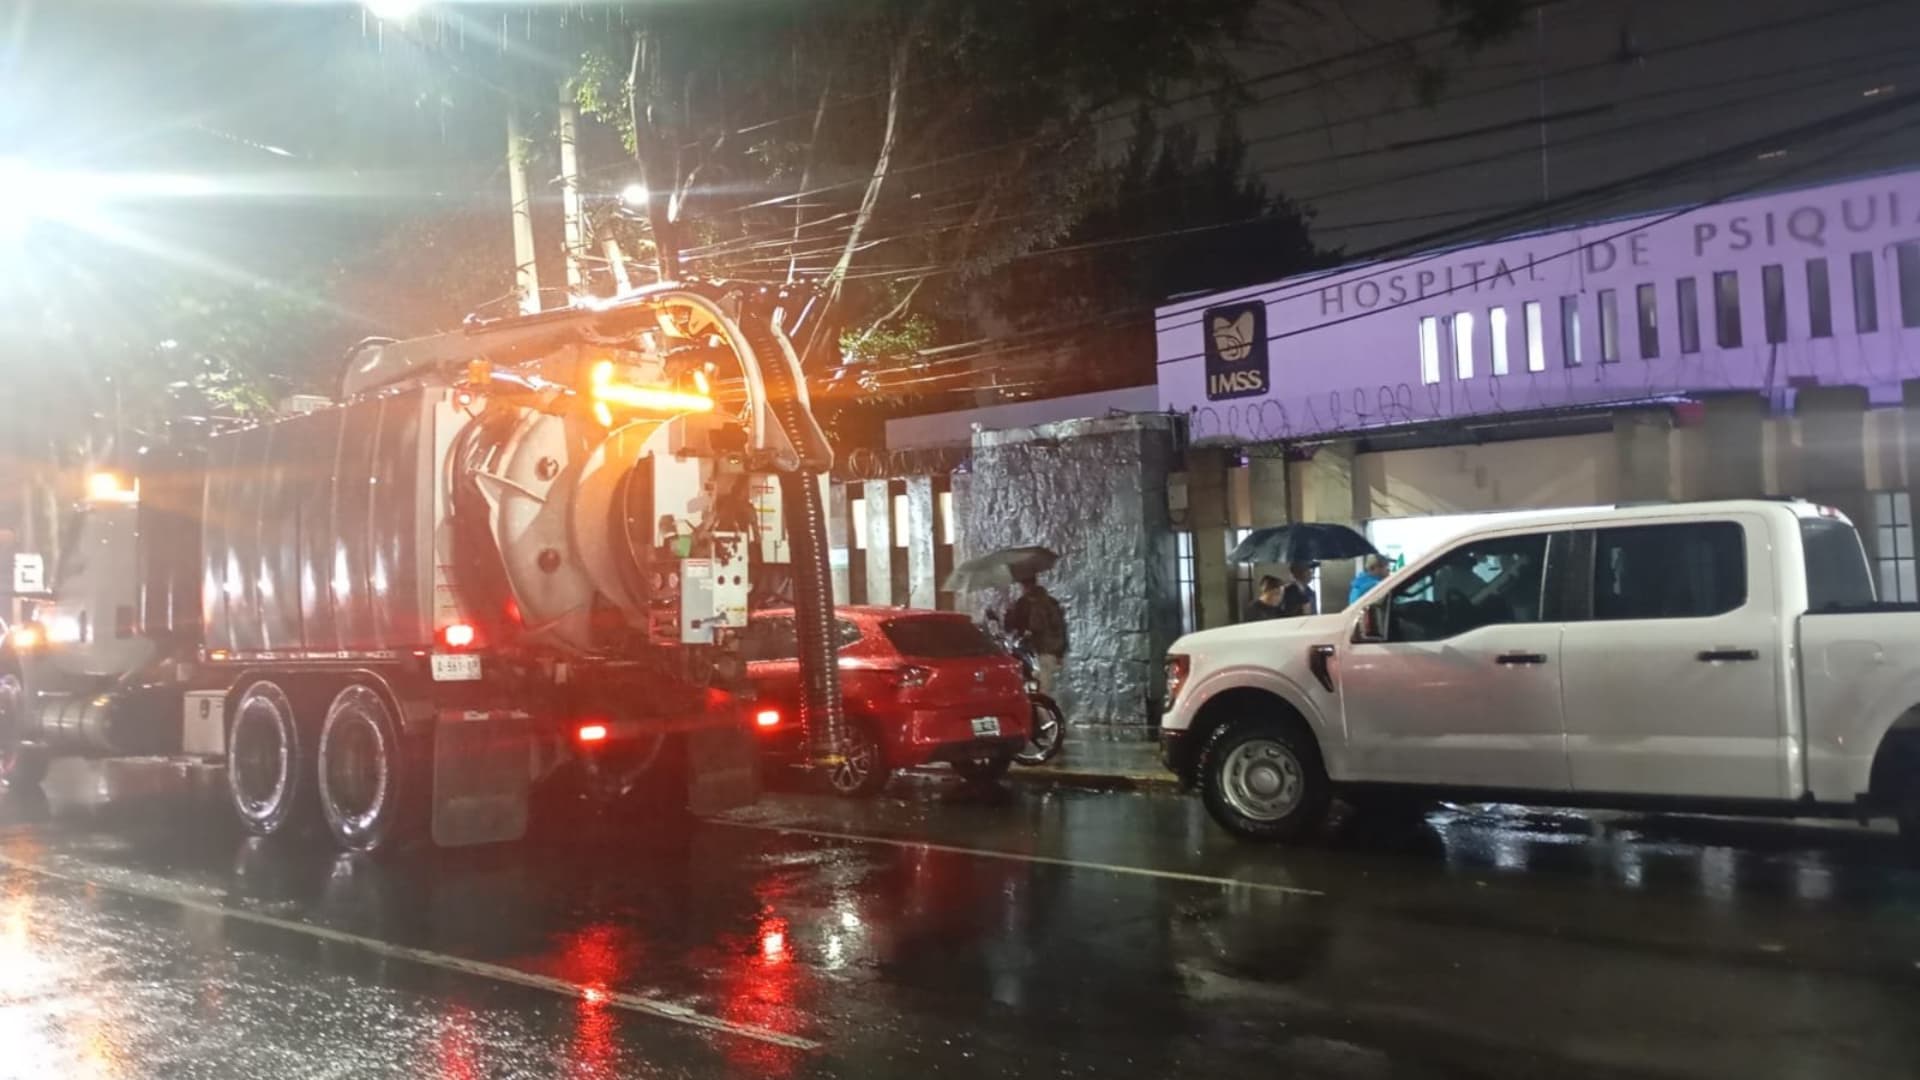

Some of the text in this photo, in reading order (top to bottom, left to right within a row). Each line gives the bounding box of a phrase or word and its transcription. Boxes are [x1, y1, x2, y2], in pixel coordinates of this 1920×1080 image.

[1320, 191, 1920, 315] HOSPITAL DE PSIQUI
[1210, 369, 1263, 395] IMSS
